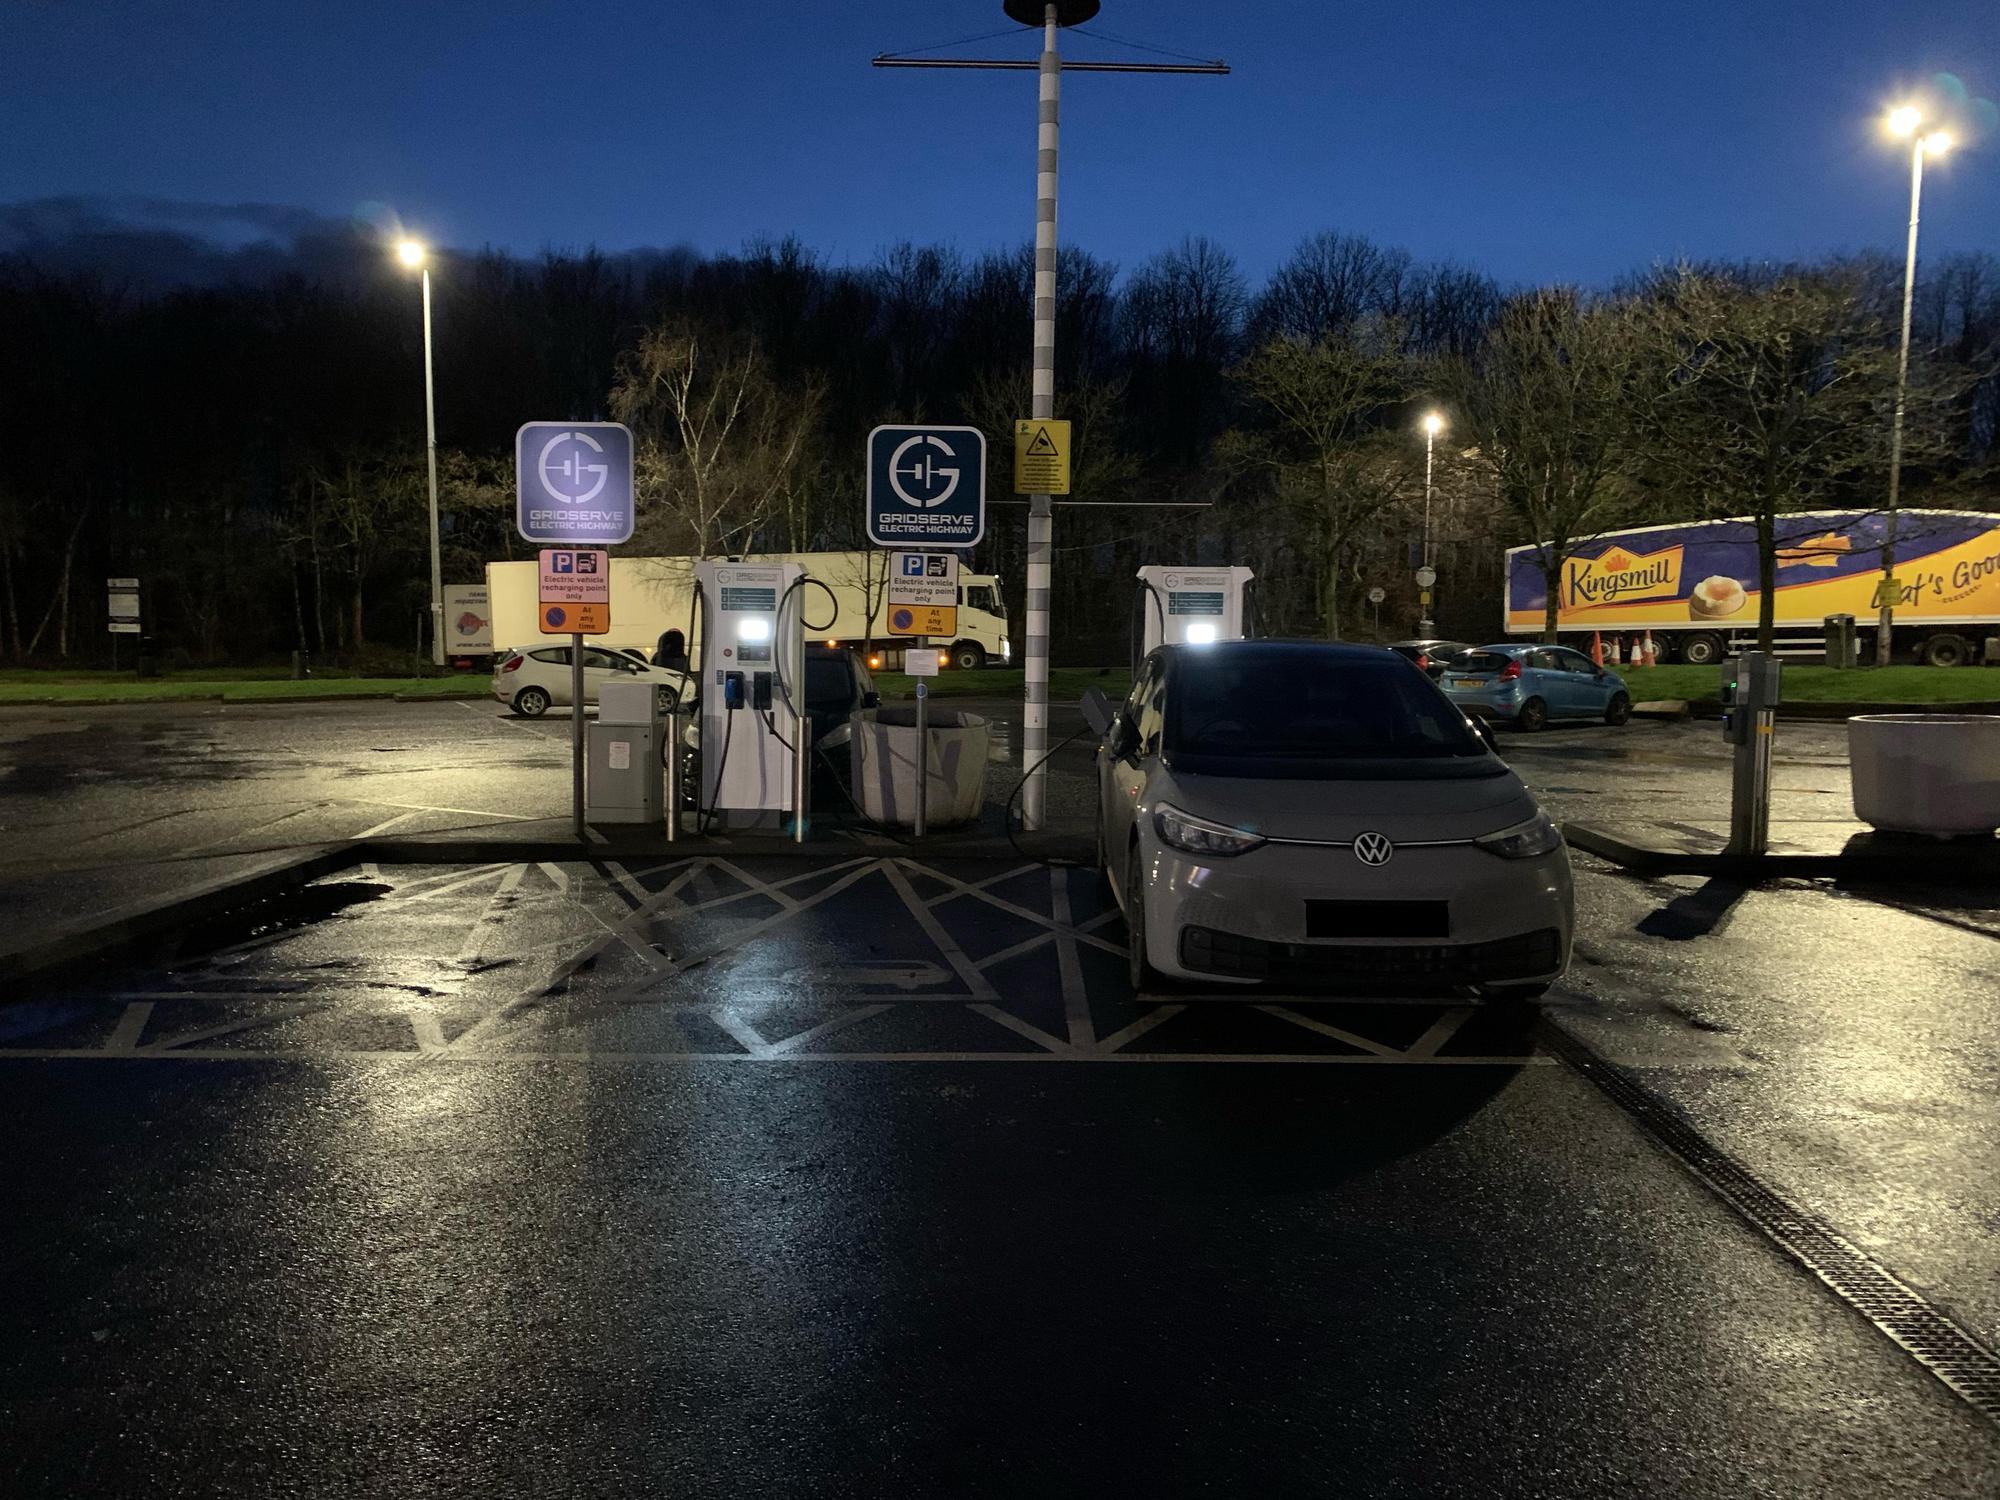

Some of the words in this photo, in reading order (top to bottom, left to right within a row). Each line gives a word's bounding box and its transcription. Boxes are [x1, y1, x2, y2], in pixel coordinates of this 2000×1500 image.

[529, 510, 624, 521] GRIDSERVE
[879, 513, 974, 525] GRIDSERVE
[529, 521, 575, 530] ELECTRIC
[577, 521, 624, 530] HIGHWAY
[879, 524, 925, 533] ELECTRIC
[926, 525, 973, 534] HIGHWAY
[557, 554, 570, 572] P
[907, 557, 921, 574] P
[544, 575, 574, 583] Electric
[894, 577, 924, 585] Electric
[1570, 558, 1676, 606] Kingsmill
[542, 584, 584, 592] recharging
[891, 586, 933, 595] recharging
[935, 587, 955, 595] point
[915, 595, 931, 603] only
[926, 625, 943, 633] time
